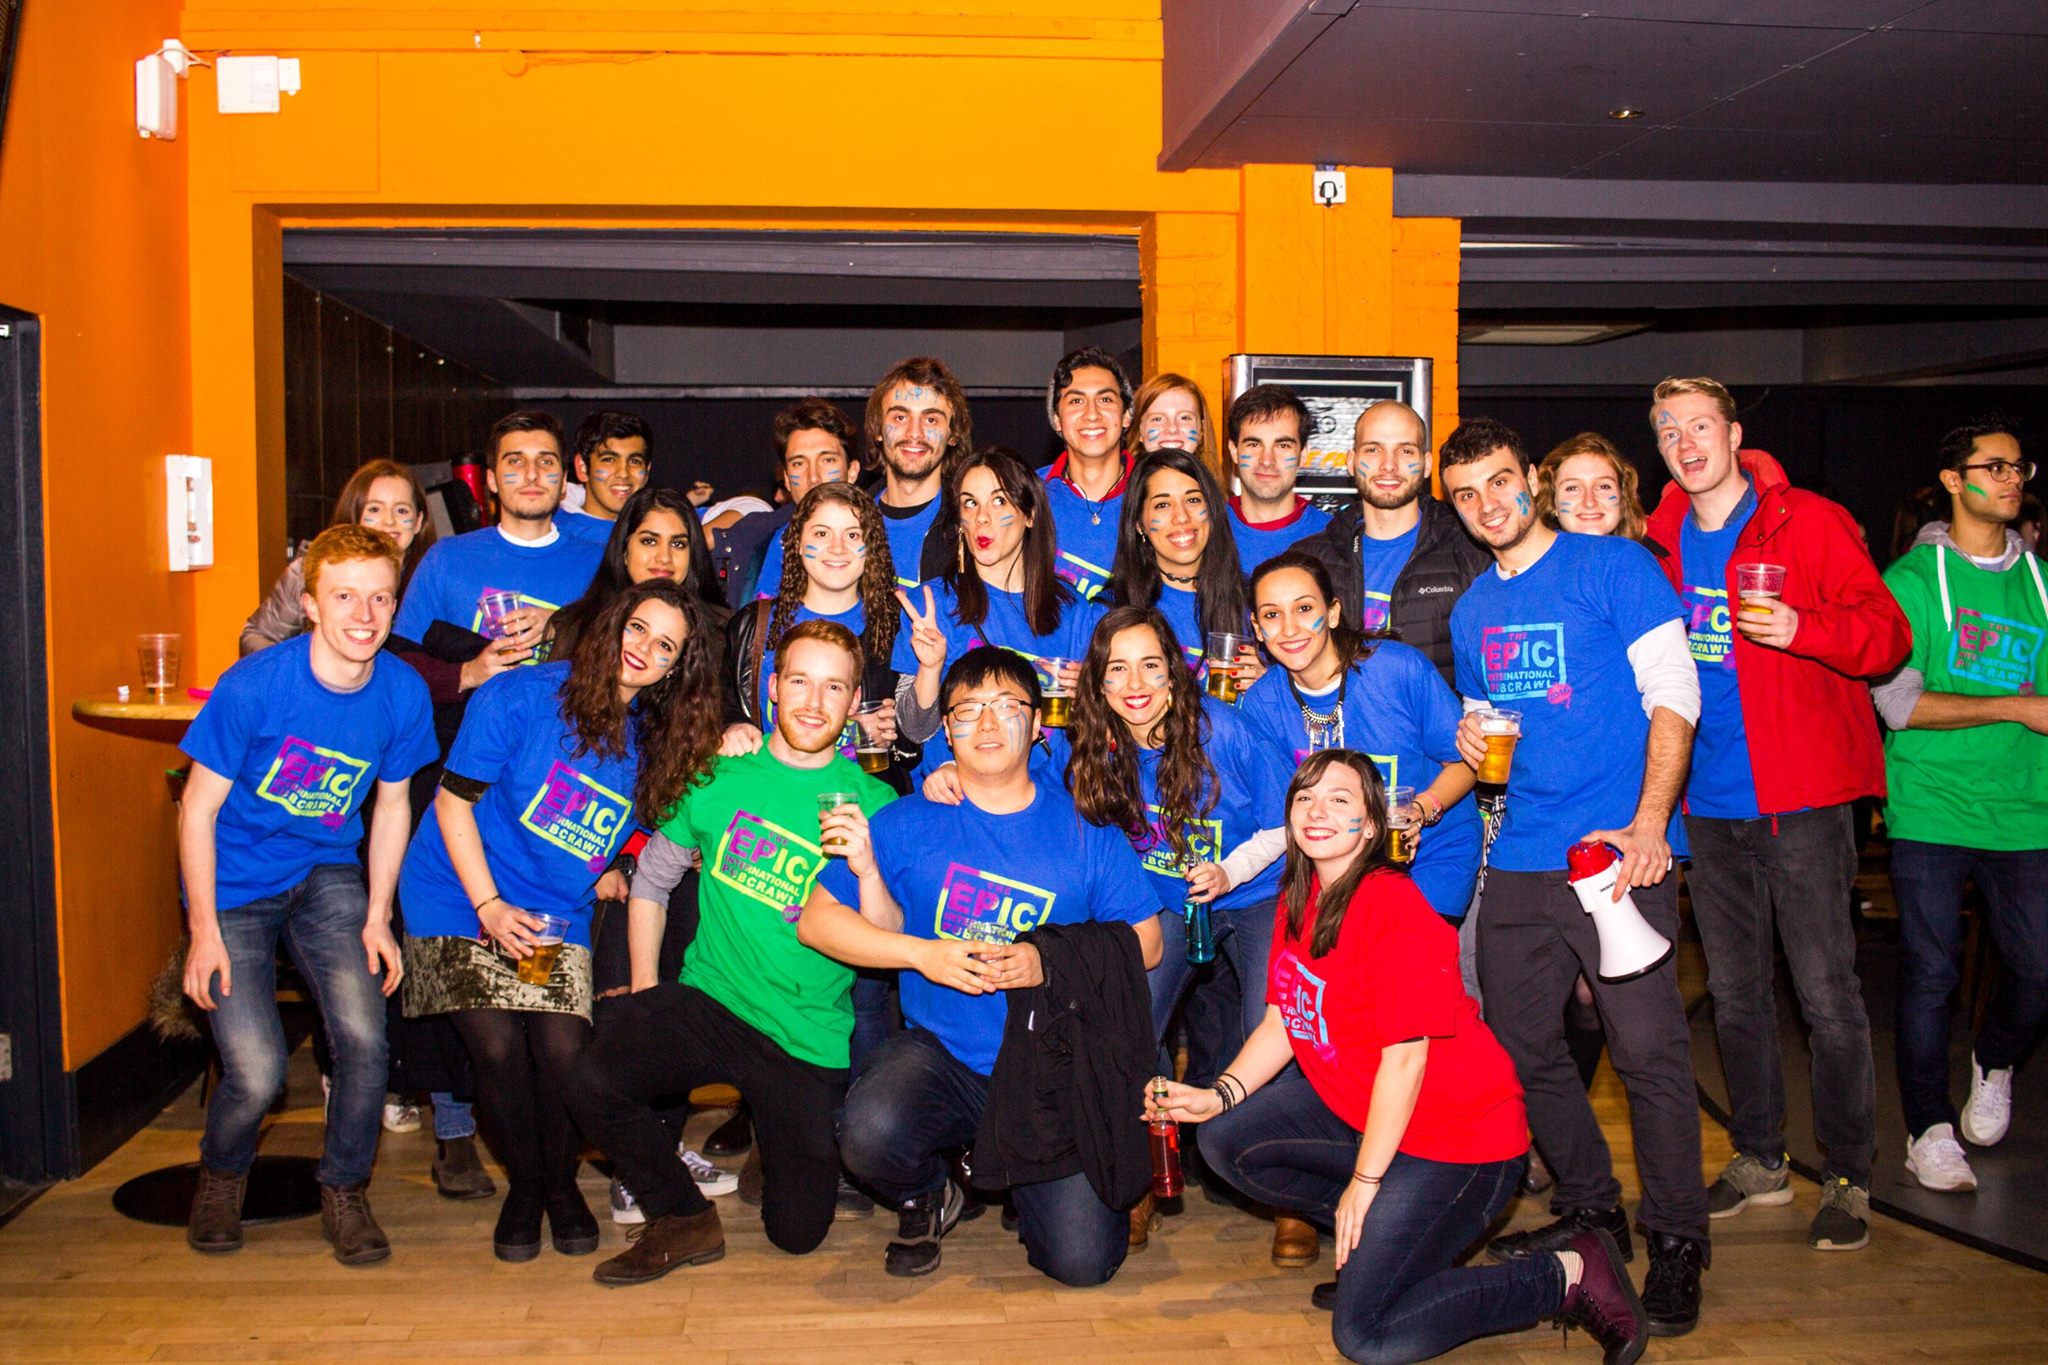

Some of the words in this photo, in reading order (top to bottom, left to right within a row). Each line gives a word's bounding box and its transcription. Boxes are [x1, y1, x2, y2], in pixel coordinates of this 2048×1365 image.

[1487, 640, 1555, 670] EPIC
[1508, 632, 1527, 640] THE
[1960, 623, 2031, 662] EPIC
[1488, 671, 1555, 681] INTERNATIONAL
[280, 753, 352, 797] EPIC
[544, 780, 617, 836] EPIC
[725, 855, 800, 897] INTERNATIONAL
[728, 827, 810, 885] EPIC
[722, 864, 795, 906] PUBCRAWL
[948, 881, 1038, 932] EPIC
